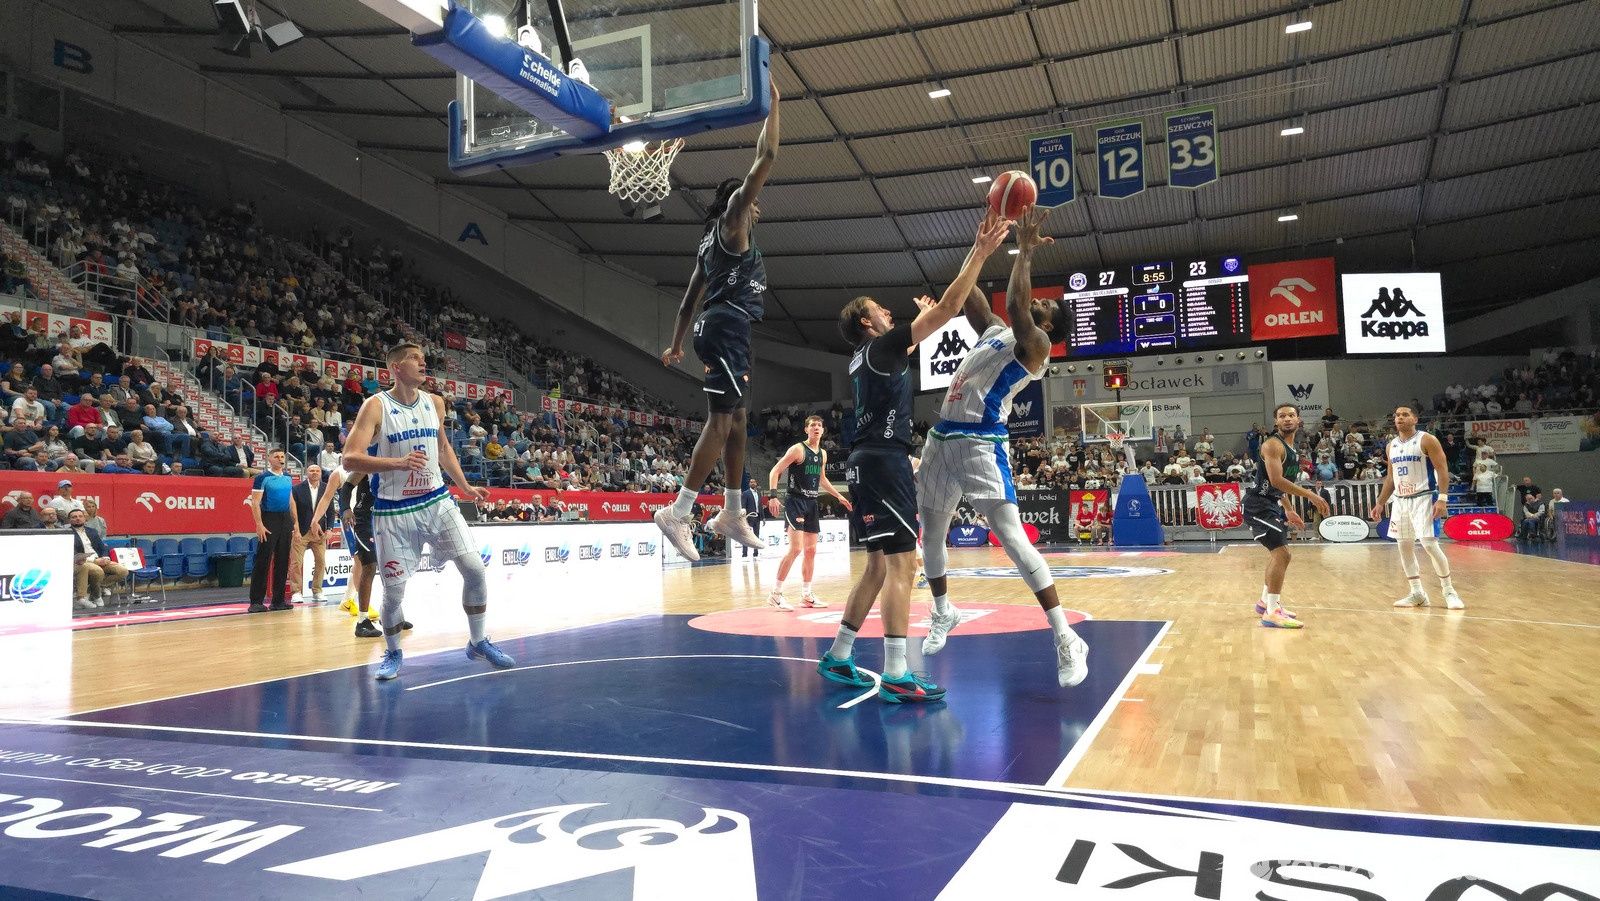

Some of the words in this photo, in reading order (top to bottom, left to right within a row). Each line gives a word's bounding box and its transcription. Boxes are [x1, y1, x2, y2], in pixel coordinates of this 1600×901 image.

[53, 39, 94, 74] B
[522, 54, 561, 88] Schelde
[1168, 119, 1214, 133] SZEWCZYK
[1098, 132, 1141, 145] GRISZCZUK
[1039, 143, 1064, 154] PLUTA
[1170, 135, 1215, 170] 33
[1102, 147, 1139, 181] 12
[1034, 158, 1071, 190] 10
[457, 222, 489, 246] A
[1189, 261, 1207, 276] 23
[1099, 271, 1115, 286] 27
[1142, 272, 1165, 283] 8:55
[1142, 301, 1146, 311] 1
[1159, 299, 1166, 309] 0
[1264, 310, 1324, 327] ORLEN
[1360, 320, 1429, 340] Kappa
[1128, 374, 1204, 390] ocławek
[1471, 420, 1530, 433] DUSZPOL
[1397, 466, 1408, 476] 20
[165, 496, 215, 510] ORLEN
[567, 502, 588, 512] ORLEN
[611, 503, 630, 513] ORLEN
[66, 756, 233, 781] dobrego
[232, 771, 401, 794] Miasto
